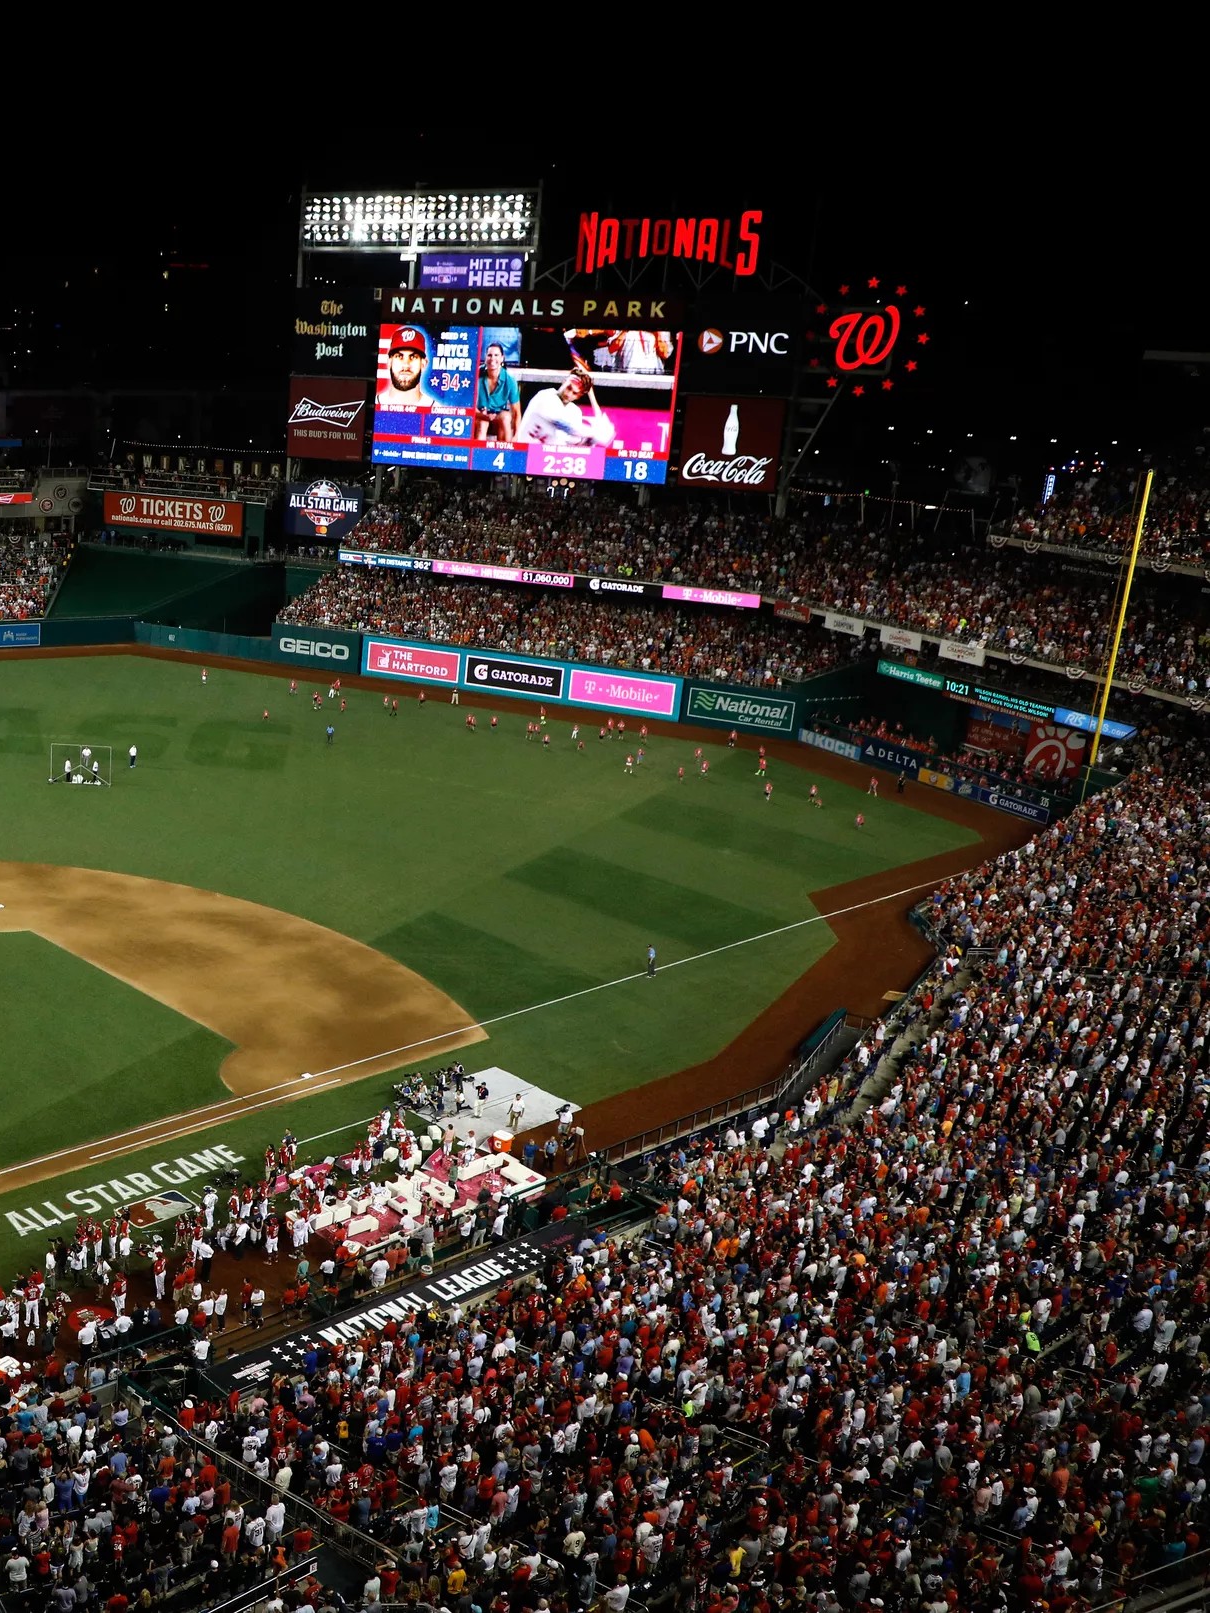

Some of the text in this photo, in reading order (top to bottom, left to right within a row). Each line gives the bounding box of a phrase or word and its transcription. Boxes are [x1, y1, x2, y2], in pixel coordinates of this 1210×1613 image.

[576, 211, 763, 275] NATIONALS
[470, 258, 509, 270] HIT IT
[468, 271, 522, 287] HERE
[321, 300, 344, 317] The
[391, 297, 666, 318] NATIONALS PARK
[295, 318, 367, 339] Washington
[829, 305, 900, 370] W
[315, 342, 344, 360] Post
[437, 344, 469, 357] BRYCE
[729, 331, 789, 354] PNC
[432, 357, 472, 371] HARPER
[441, 374, 460, 391] 34
[295, 401, 356, 418] Budweiser
[293, 429, 358, 440] THIS BUD'S FOR YOU.
[430, 418, 470, 436] 439'
[493, 453, 505, 469] 4
[543, 455, 586, 476] 2:38
[624, 461, 647, 480] 18
[141, 498, 203, 520] TICKETS
[289, 495, 306, 508] ALL
[308, 496, 331, 510] STAR
[333, 499, 358, 513] GAME
[111, 514, 152, 525] nationals.com
[161, 518, 172, 527] call
[173, 519, 214, 532] 202.675.NATS
[523, 571, 569, 585] $1,060,000
[601, 582, 644, 593] GATORADE
[279, 637, 349, 660] GEICO
[393, 650, 412, 661] THE
[392, 661, 448, 677] HARTFORD
[474, 664, 554, 688] G GATORADE
[889, 666, 941, 687] Harris Teeter
[946, 680, 969, 695] 10:21
[715, 696, 787, 720] National
[974, 688, 992, 697] WILSON
[993, 692, 1010, 701] RAMOS,
[1029, 702, 1055, 713] TEAMMATE
[991, 698, 1002, 706] LOVE
[738, 715, 782, 727] Car Rental
[813, 736, 856, 758] KOCH
[878, 750, 917, 769] DELTA
[989, 794, 1038, 817] G GATORADE
[4, 1143, 247, 1237] ALL STAR GAME
[426, 1258, 512, 1301] LEAGUE
